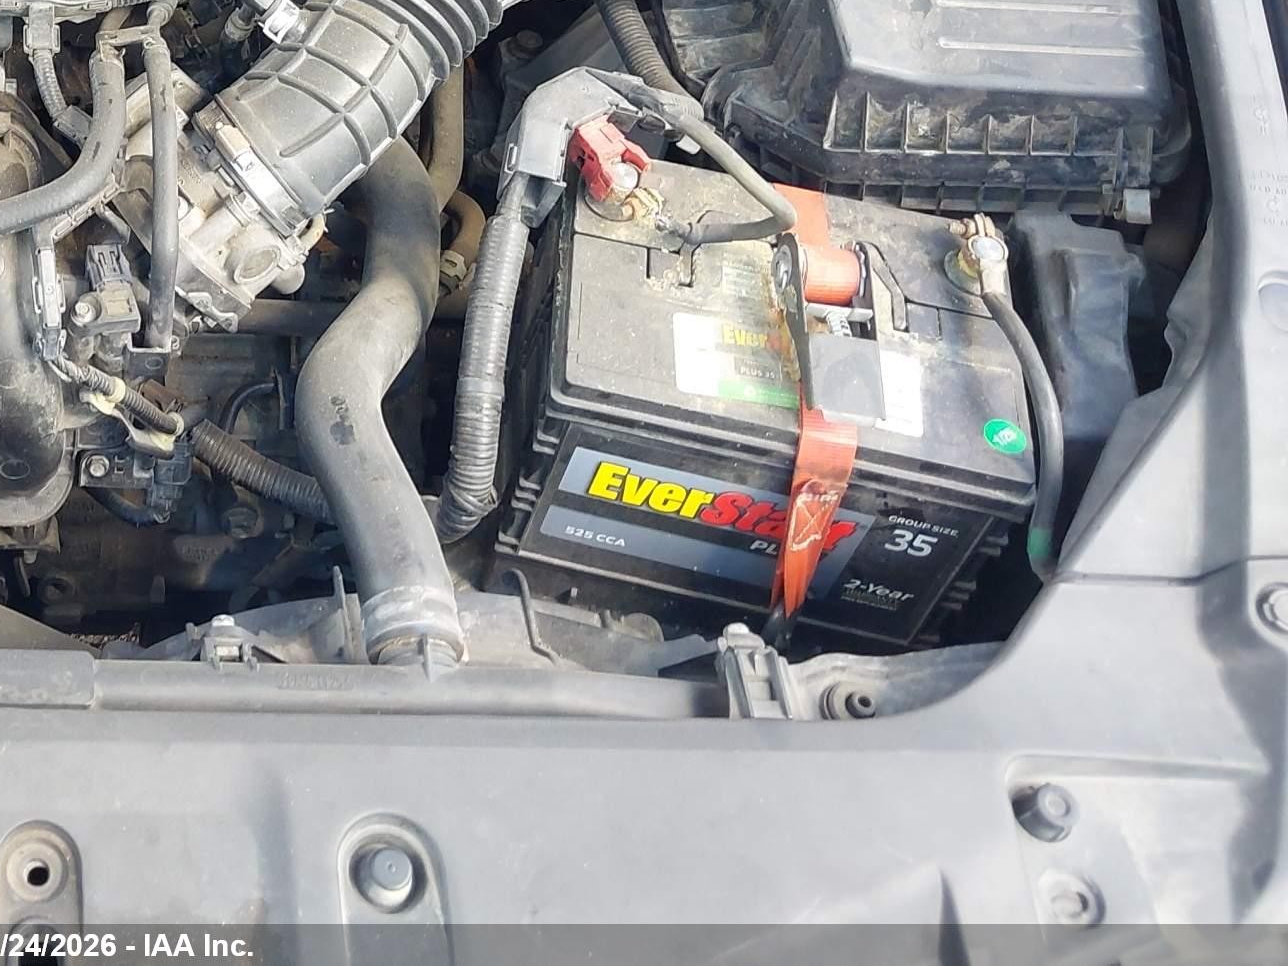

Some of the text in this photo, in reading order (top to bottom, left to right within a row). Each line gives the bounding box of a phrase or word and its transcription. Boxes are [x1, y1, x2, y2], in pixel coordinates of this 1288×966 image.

[587, 460, 857, 551] EverStat
[564, 525, 626, 547] 525 CCA
[888, 515, 960, 537] GROUP SIZE
[750, 540, 779, 555] PL
[883, 528, 939, 557] 35
[842, 578, 915, 601] 2-Year
